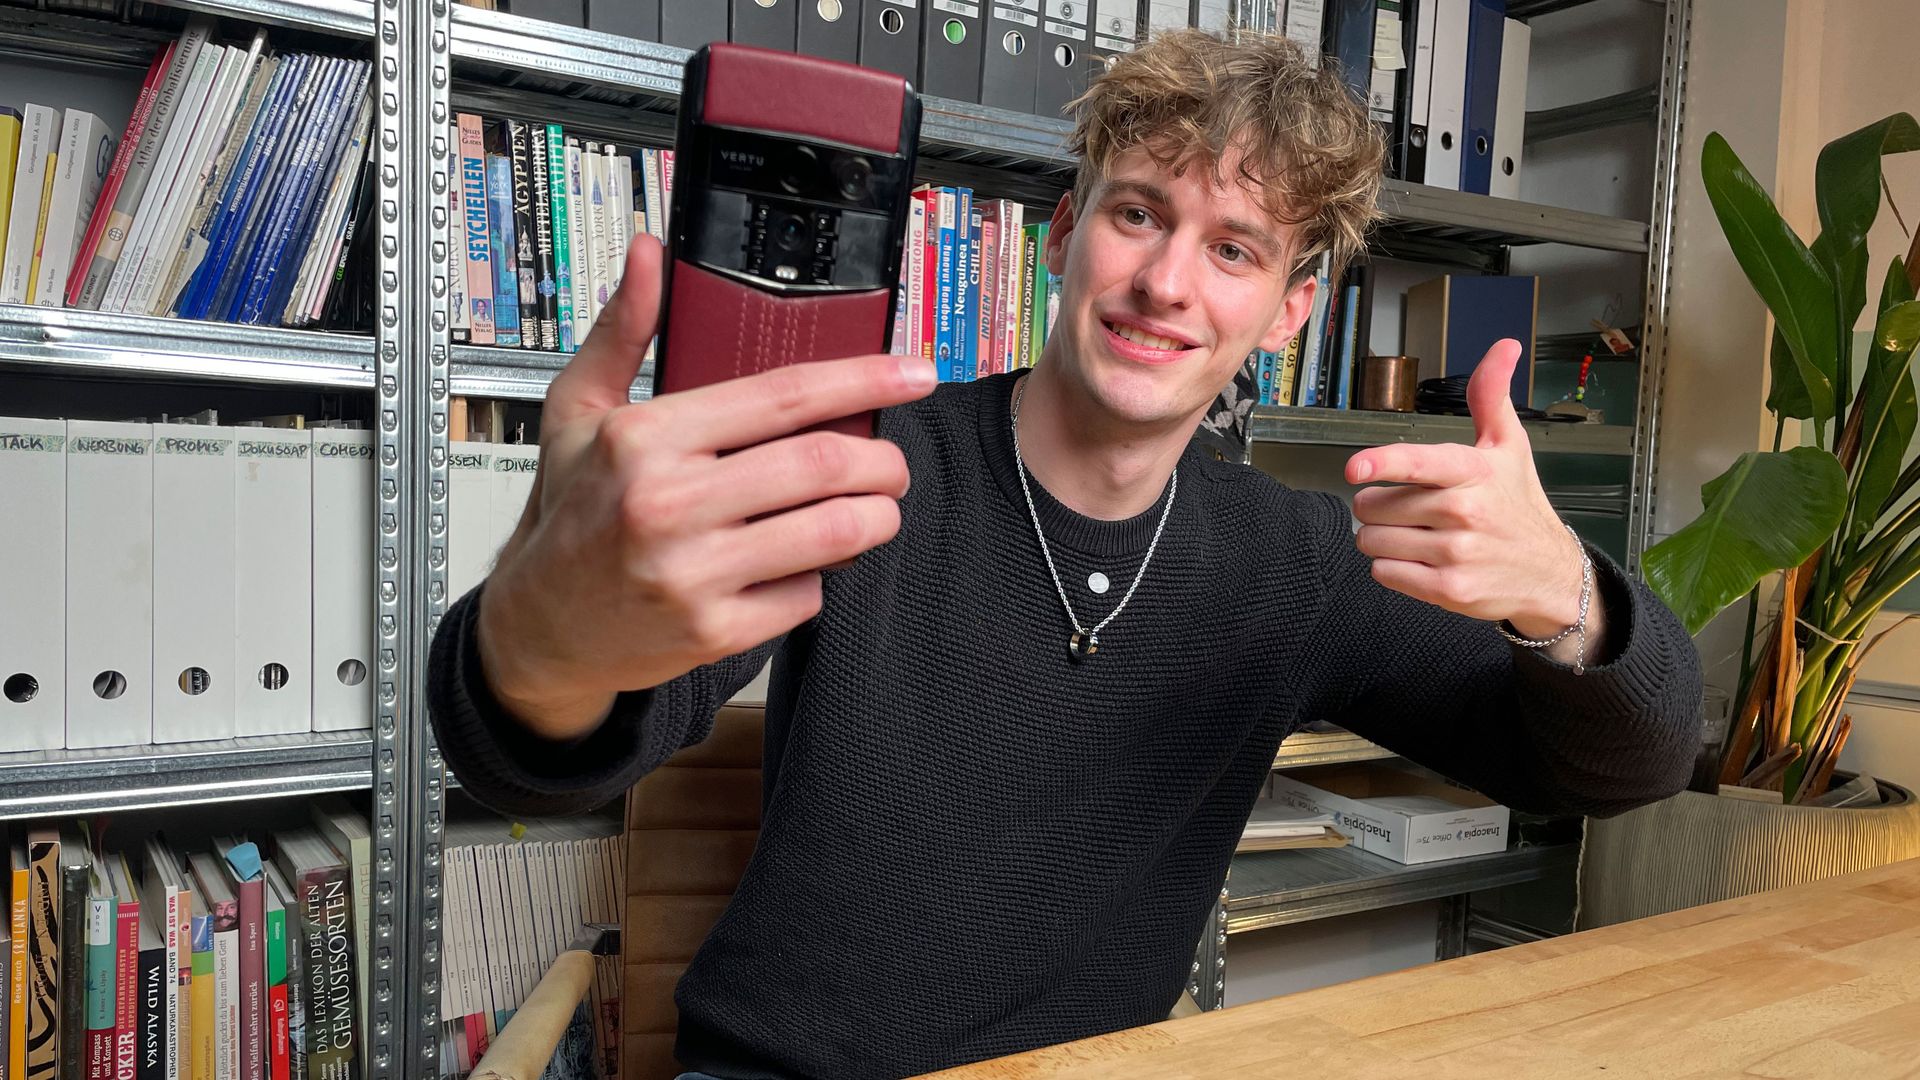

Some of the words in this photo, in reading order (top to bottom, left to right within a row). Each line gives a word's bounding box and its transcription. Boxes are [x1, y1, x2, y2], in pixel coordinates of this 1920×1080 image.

[137, 138, 156, 169] Atlas
[150, 118, 163, 139] der
[157, 32, 201, 116] Globalisierung
[514, 124, 530, 215] ÄGYPTEN
[550, 128, 566, 197] TAHITI
[720, 149, 765, 167] VERTU
[532, 128, 552, 256] MITTELAMERIKA
[463, 157, 489, 263] SEYCHELLEN
[573, 199, 584, 236] JAIPUR
[592, 206, 606, 247] YORK
[608, 216, 624, 260] WIEN
[576, 247, 587, 276] AGRA
[595, 250, 608, 280] NEW
[912, 228, 922, 301] HONGKONG
[970, 238, 980, 284] CHILE
[1028, 241, 1036, 266] NEW
[954, 244, 968, 315] Neuguinea
[986, 244, 994, 294] SÜDINDIEN
[1024, 266, 1034, 305] MEXICO
[577, 282, 588, 320] DELHI
[940, 285, 952, 332] Handbook
[982, 295, 991, 340] INDIEN
[1020, 307, 1032, 368] HANDBOOK
[1289, 331, 1300, 350] GE
[1286, 354, 1296, 368] SO
[0, 434, 44, 450] TALK
[78, 438, 144, 454] WERBUNG
[165, 438, 220, 453] PROMIS
[240, 442, 307, 457] DOKUSOAP
[320, 442, 376, 460] COMEDY
[448, 454, 482, 467] SSEN
[1344, 814, 1392, 843] Inacopia
[1432, 833, 1452, 842] Office
[1464, 826, 1500, 838] Inacopia
[15, 898, 26, 935] LANKA
[168, 895, 176, 913] WAS
[308, 884, 321, 927] ALTEN
[168, 915, 176, 928] IST
[14, 937, 24, 954] SRI
[168, 931, 176, 948] WAS
[310, 932, 324, 958] DER
[14, 960, 24, 981] durch
[169, 975, 176, 984] 74
[220, 957, 228, 980] lieben
[325, 880, 352, 1050] GEMÜSESORTEN
[14, 981, 23, 1004] Reise
[128, 976, 136, 1028] EXPEDITIONEN
[148, 966, 161, 1010] WILD
[250, 980, 258, 1011] zurück
[313, 964, 327, 1025] LEXIKON
[222, 1010, 228, 1020] du
[250, 1012, 258, 1036] kehrt
[146, 1012, 160, 1068] ALASKA
[169, 993, 177, 1078] NATURKATASTROPHEN
[220, 1020, 230, 1043] guckst
[316, 1028, 328, 1054] DAS
[93, 1034, 101, 1066] Kompass
[117, 1031, 135, 1080] CKER
[250, 1038, 259, 1068] Vielfalt
